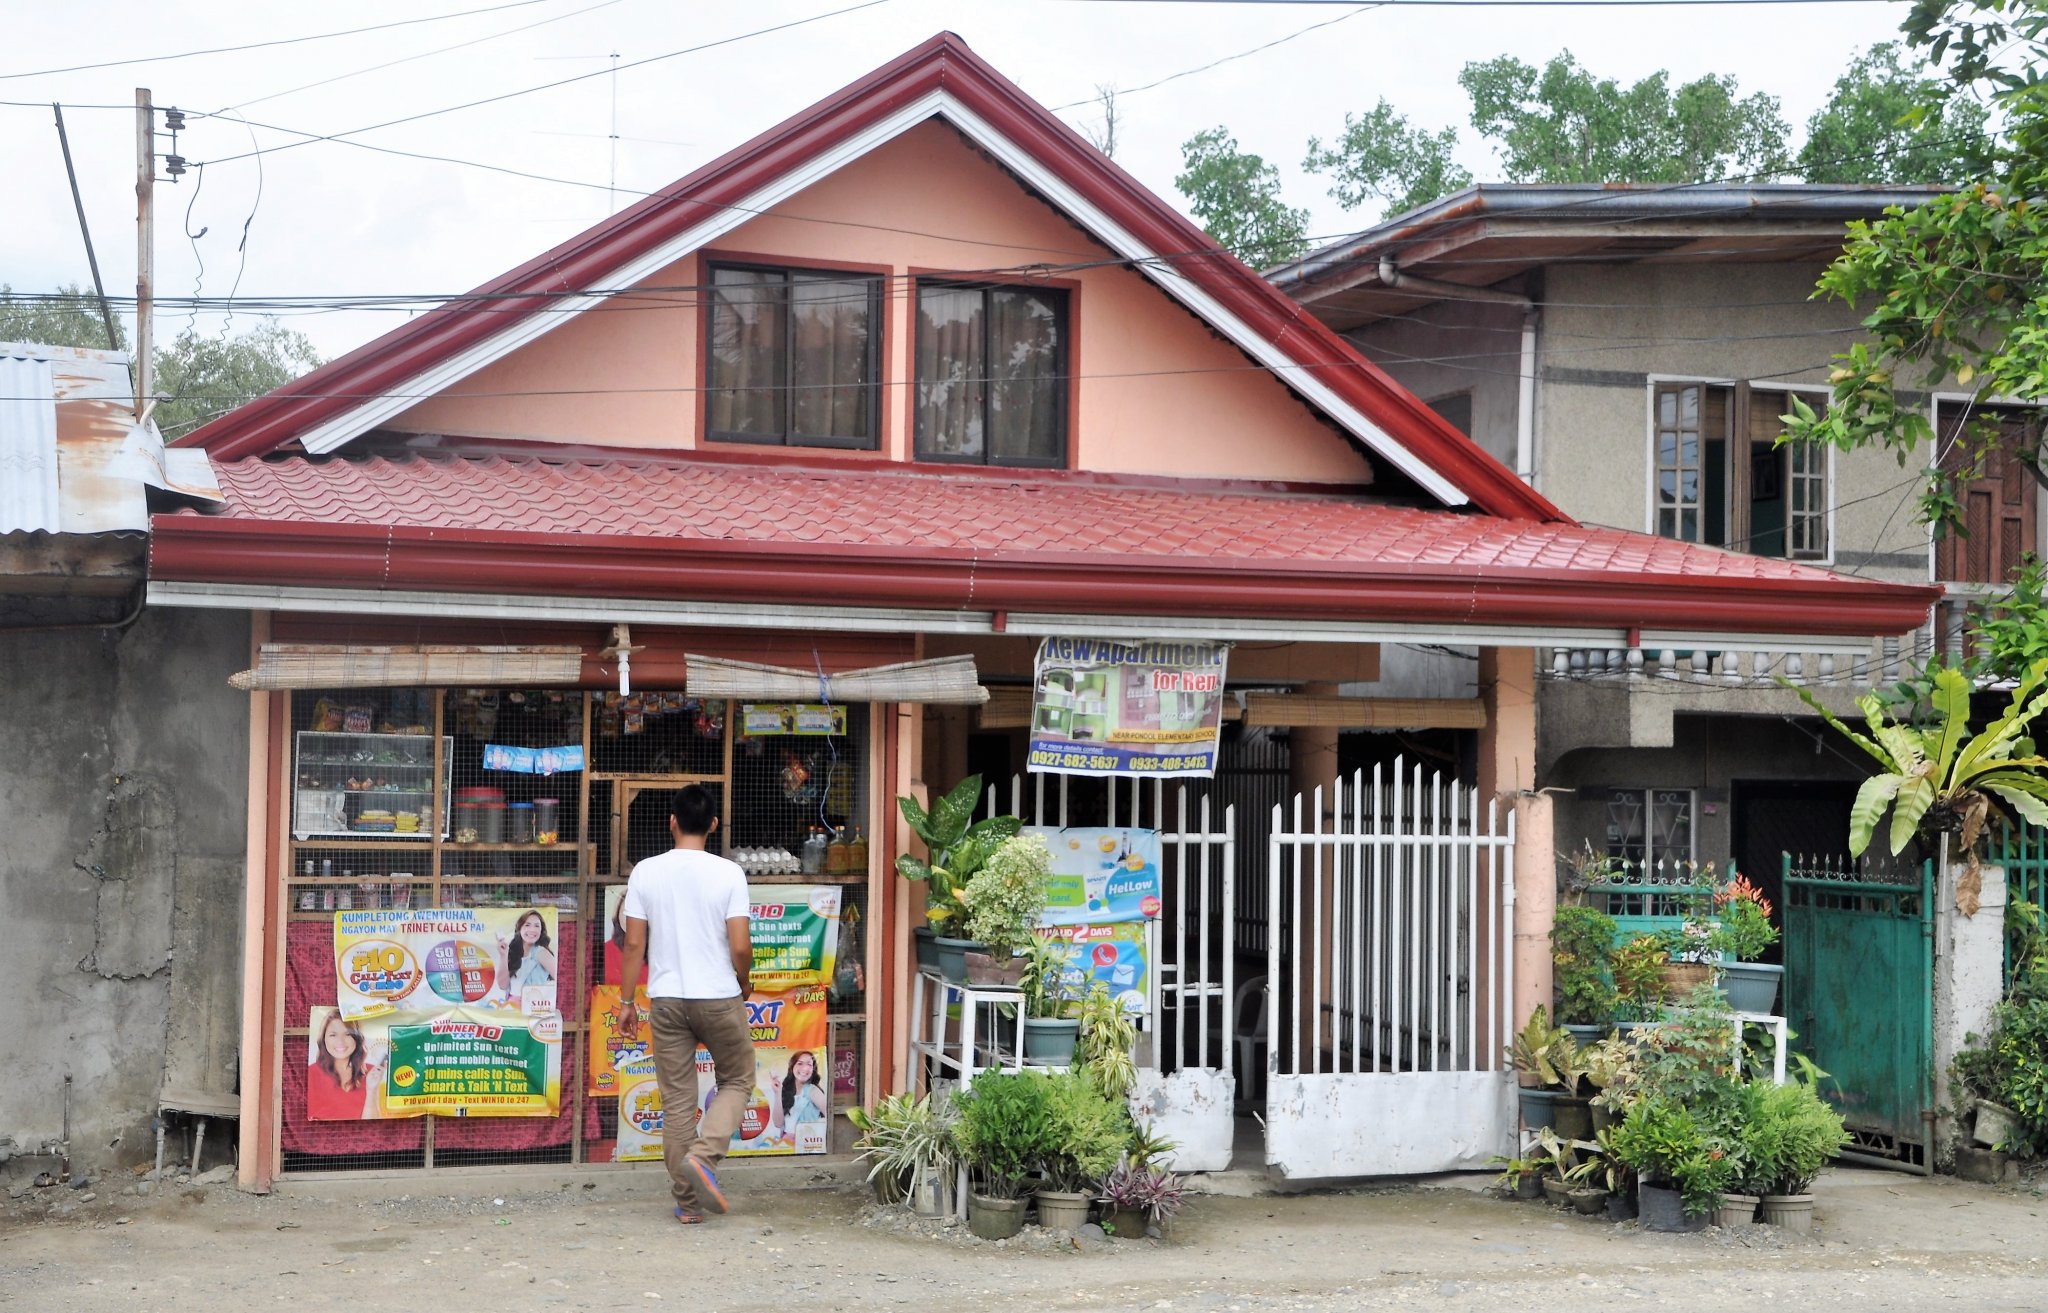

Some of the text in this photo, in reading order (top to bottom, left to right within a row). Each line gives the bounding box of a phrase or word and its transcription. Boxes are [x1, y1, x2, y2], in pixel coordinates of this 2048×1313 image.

[1096, 641, 1221, 665] Apartment
[1153, 670, 1180, 690] for
[1031, 750, 1207, 770] 0927-682-5637 0933-408-5413
[341, 911, 476, 923] KUMPLETONG AWENTUHAN,
[760, 905, 784, 919] 10
[341, 922, 485, 934] NGAYON MAY TRINET CALLS PA!
[759, 922, 776, 931] Sun
[779, 922, 802, 931] texts
[777, 934, 811, 943] internet
[1072, 924, 1090, 944] 2
[1090, 928, 1112, 937] DAYS
[435, 947, 453, 958] 50
[461, 946, 475, 956] 10
[752, 946, 776, 957] calls
[777, 947, 788, 957] to
[753, 958, 776, 969] Talk
[465, 971, 481, 982] 10
[794, 990, 825, 1005] 2 DAYS
[432, 1025, 502, 1040] WINNER 10
[751, 1028, 779, 1040] SUN
[424, 1041, 519, 1056] Unlimited Sun texts
[424, 1055, 528, 1069] 10 mins mobile internet
[395, 1071, 414, 1082] NEW!
[424, 1069, 434, 1080] 10
[437, 1069, 462, 1080] mins
[464, 1068, 490, 1080] calls
[492, 1069, 503, 1080] to
[423, 1081, 455, 1093] Smart
[458, 1081, 466, 1093] &
[468, 1080, 490, 1093] Talk
[504, 1081, 528, 1093] Text
[417, 1096, 436, 1105] valid
[443, 1096, 457, 1106] day
[464, 1096, 480, 1104] Text
[481, 1096, 505, 1104] WIN10
[507, 1096, 514, 1104] to
[516, 1095, 529, 1104] 247
